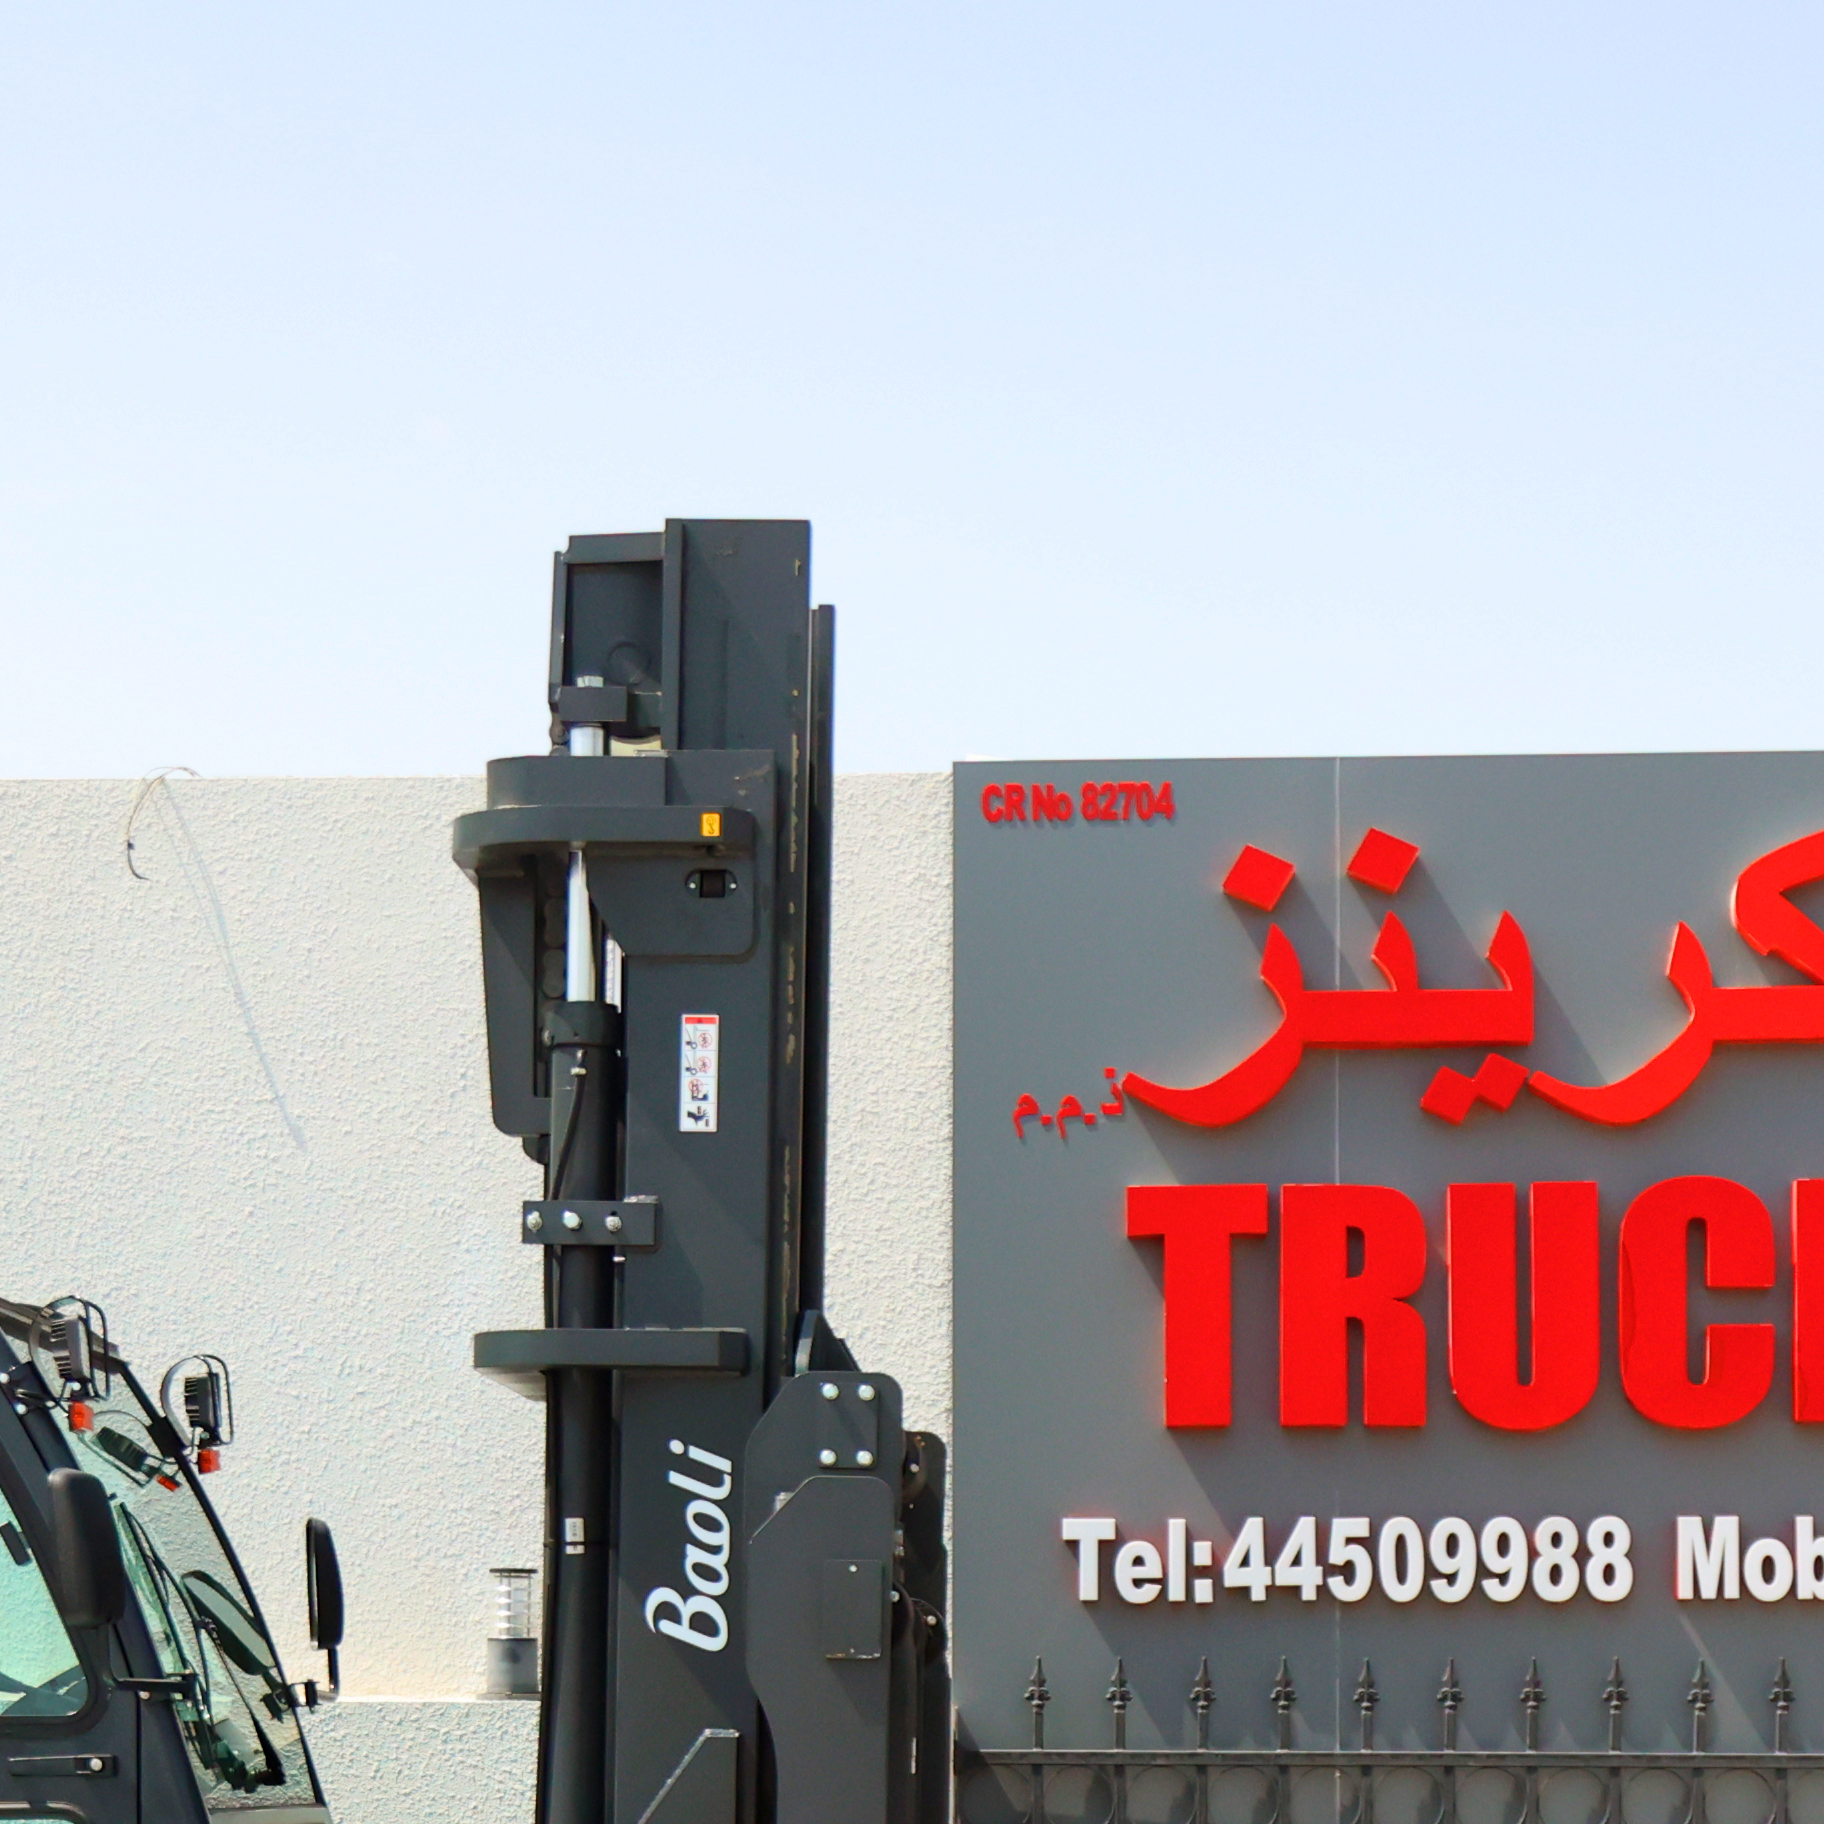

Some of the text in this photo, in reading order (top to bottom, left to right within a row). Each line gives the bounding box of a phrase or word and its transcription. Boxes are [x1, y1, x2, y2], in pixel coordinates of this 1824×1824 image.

[981, 780, 1175, 823] CR No 82704
[644, 1439, 733, 1653] Baoli
[1062, 1514, 1634, 1603] Tel:44509988
